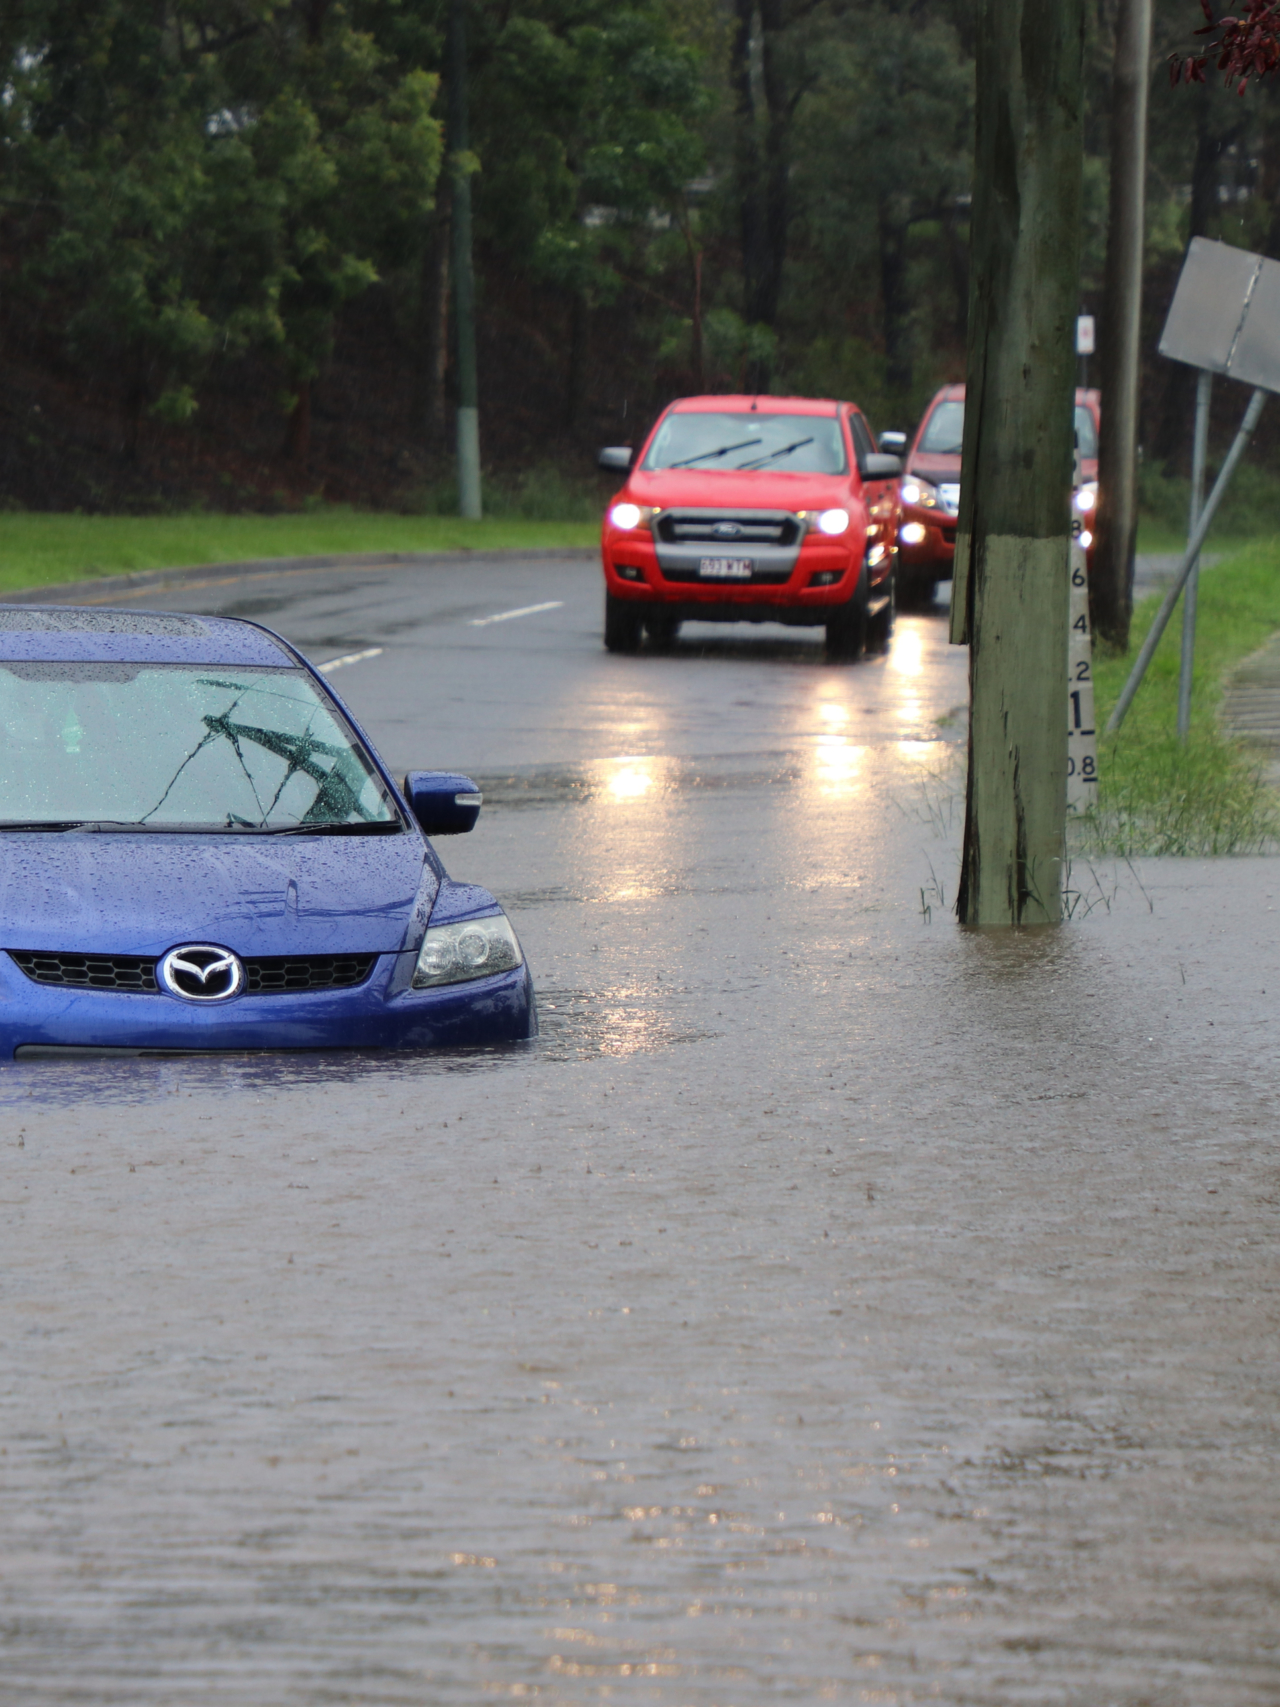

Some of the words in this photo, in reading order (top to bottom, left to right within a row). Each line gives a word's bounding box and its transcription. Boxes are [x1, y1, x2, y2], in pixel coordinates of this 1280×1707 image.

[1071, 519, 1081, 539] 8
[1072, 567, 1085, 587] 6
[1073, 614, 1087, 634] 4
[1070, 690, 1082, 728] 1
